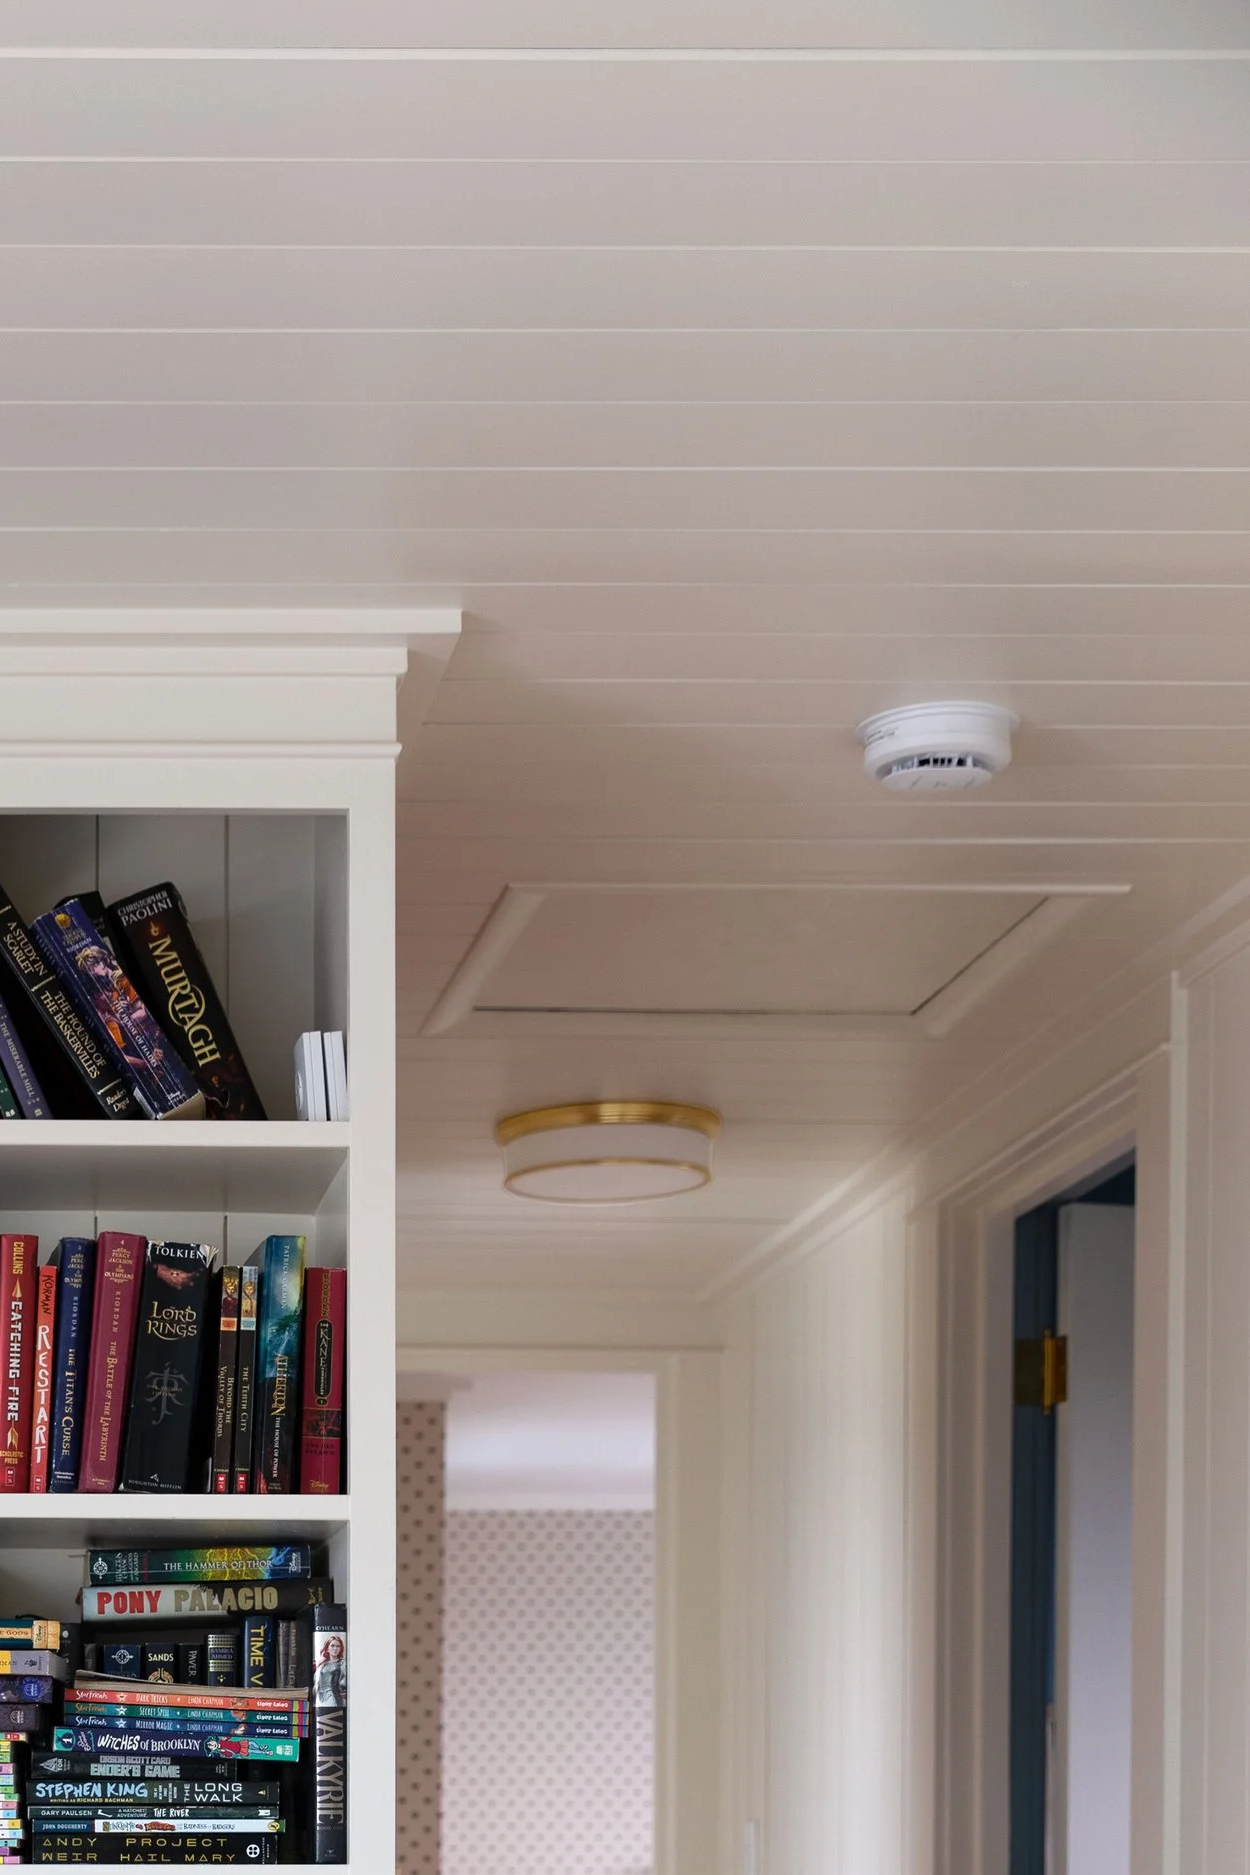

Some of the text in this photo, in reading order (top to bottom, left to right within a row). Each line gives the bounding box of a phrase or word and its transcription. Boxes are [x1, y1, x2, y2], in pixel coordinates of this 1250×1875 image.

[117, 891, 168, 917] CHRISTOPHER
[122, 899, 172, 926] PAOLINI
[3, 935, 35, 974] SCARLET
[7, 921, 47, 976] A STUDY IN
[148, 937, 222, 1066] MURTAGH
[40, 990, 99, 1079] THE BASKERVILLES
[54, 991, 107, 1067] THE HOUND OF
[12, 1241, 24, 1275] COLLINS
[154, 1245, 204, 1260] TOLKIEN
[43, 1274, 54, 1315] KORMAN
[150, 1301, 197, 1321] LORD
[146, 1320, 198, 1341] RINGS
[109, 1341, 117, 1357] THE
[105, 1357, 118, 1389] BATTLE
[6, 1386, 20, 1421] FIRE
[34, 1325, 52, 1463] RESTART
[105, 1389, 111, 1399] OF
[99, 1415, 111, 1461] LABYRINTH
[163, 1559, 273, 1571] THE HAMMER OF THOR
[97, 1586, 278, 1615] PONY PALACIO
[148, 1652, 174, 1662] SANDS
[97, 1734, 201, 1752] WITCHES of BROOKLYN
[90, 1764, 181, 1778] ENDER'S GAME
[317, 1711, 344, 1825] VALKYRIE
[35, 1782, 148, 1798] STEPHEN KING
[194, 1782, 243, 1792] LONG
[194, 1793, 243, 1803] WALK
[153, 1807, 190, 1818] THE RIVER
[42, 1838, 97, 1847] ANDY
[126, 1838, 228, 1847] PROJECT
[42, 1852, 98, 1861] WEIR
[120, 1853, 235, 1862] HAIL MARY
